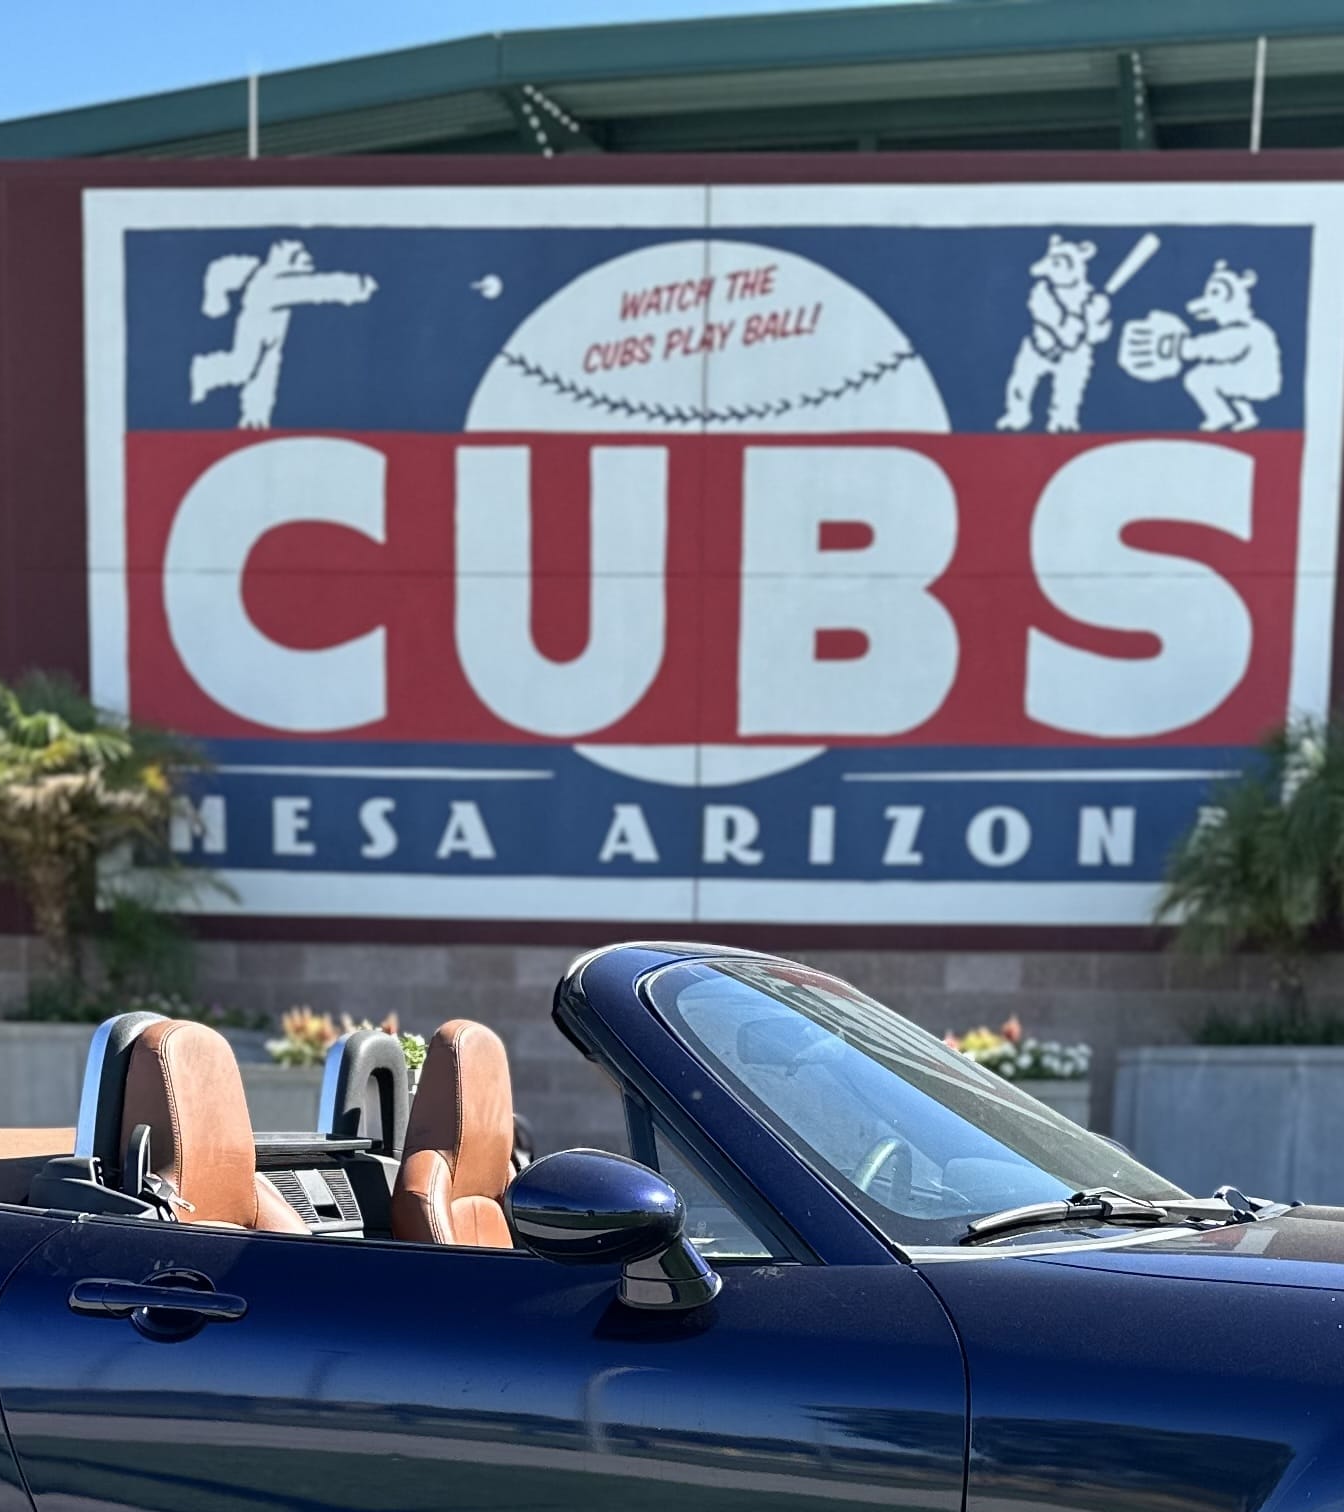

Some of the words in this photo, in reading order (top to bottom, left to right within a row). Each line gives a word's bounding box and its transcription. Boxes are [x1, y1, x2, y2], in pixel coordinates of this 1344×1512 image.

[619, 276, 715, 322] WATCH
[725, 264, 778, 303] THE
[582, 334, 655, 375] CUBS
[662, 320, 736, 361] PLAY
[741, 301, 823, 347] BALL!
[163, 436, 1255, 739] CUBS
[167, 795, 497, 860] MESA
[598, 803, 1228, 868] ARIZON
